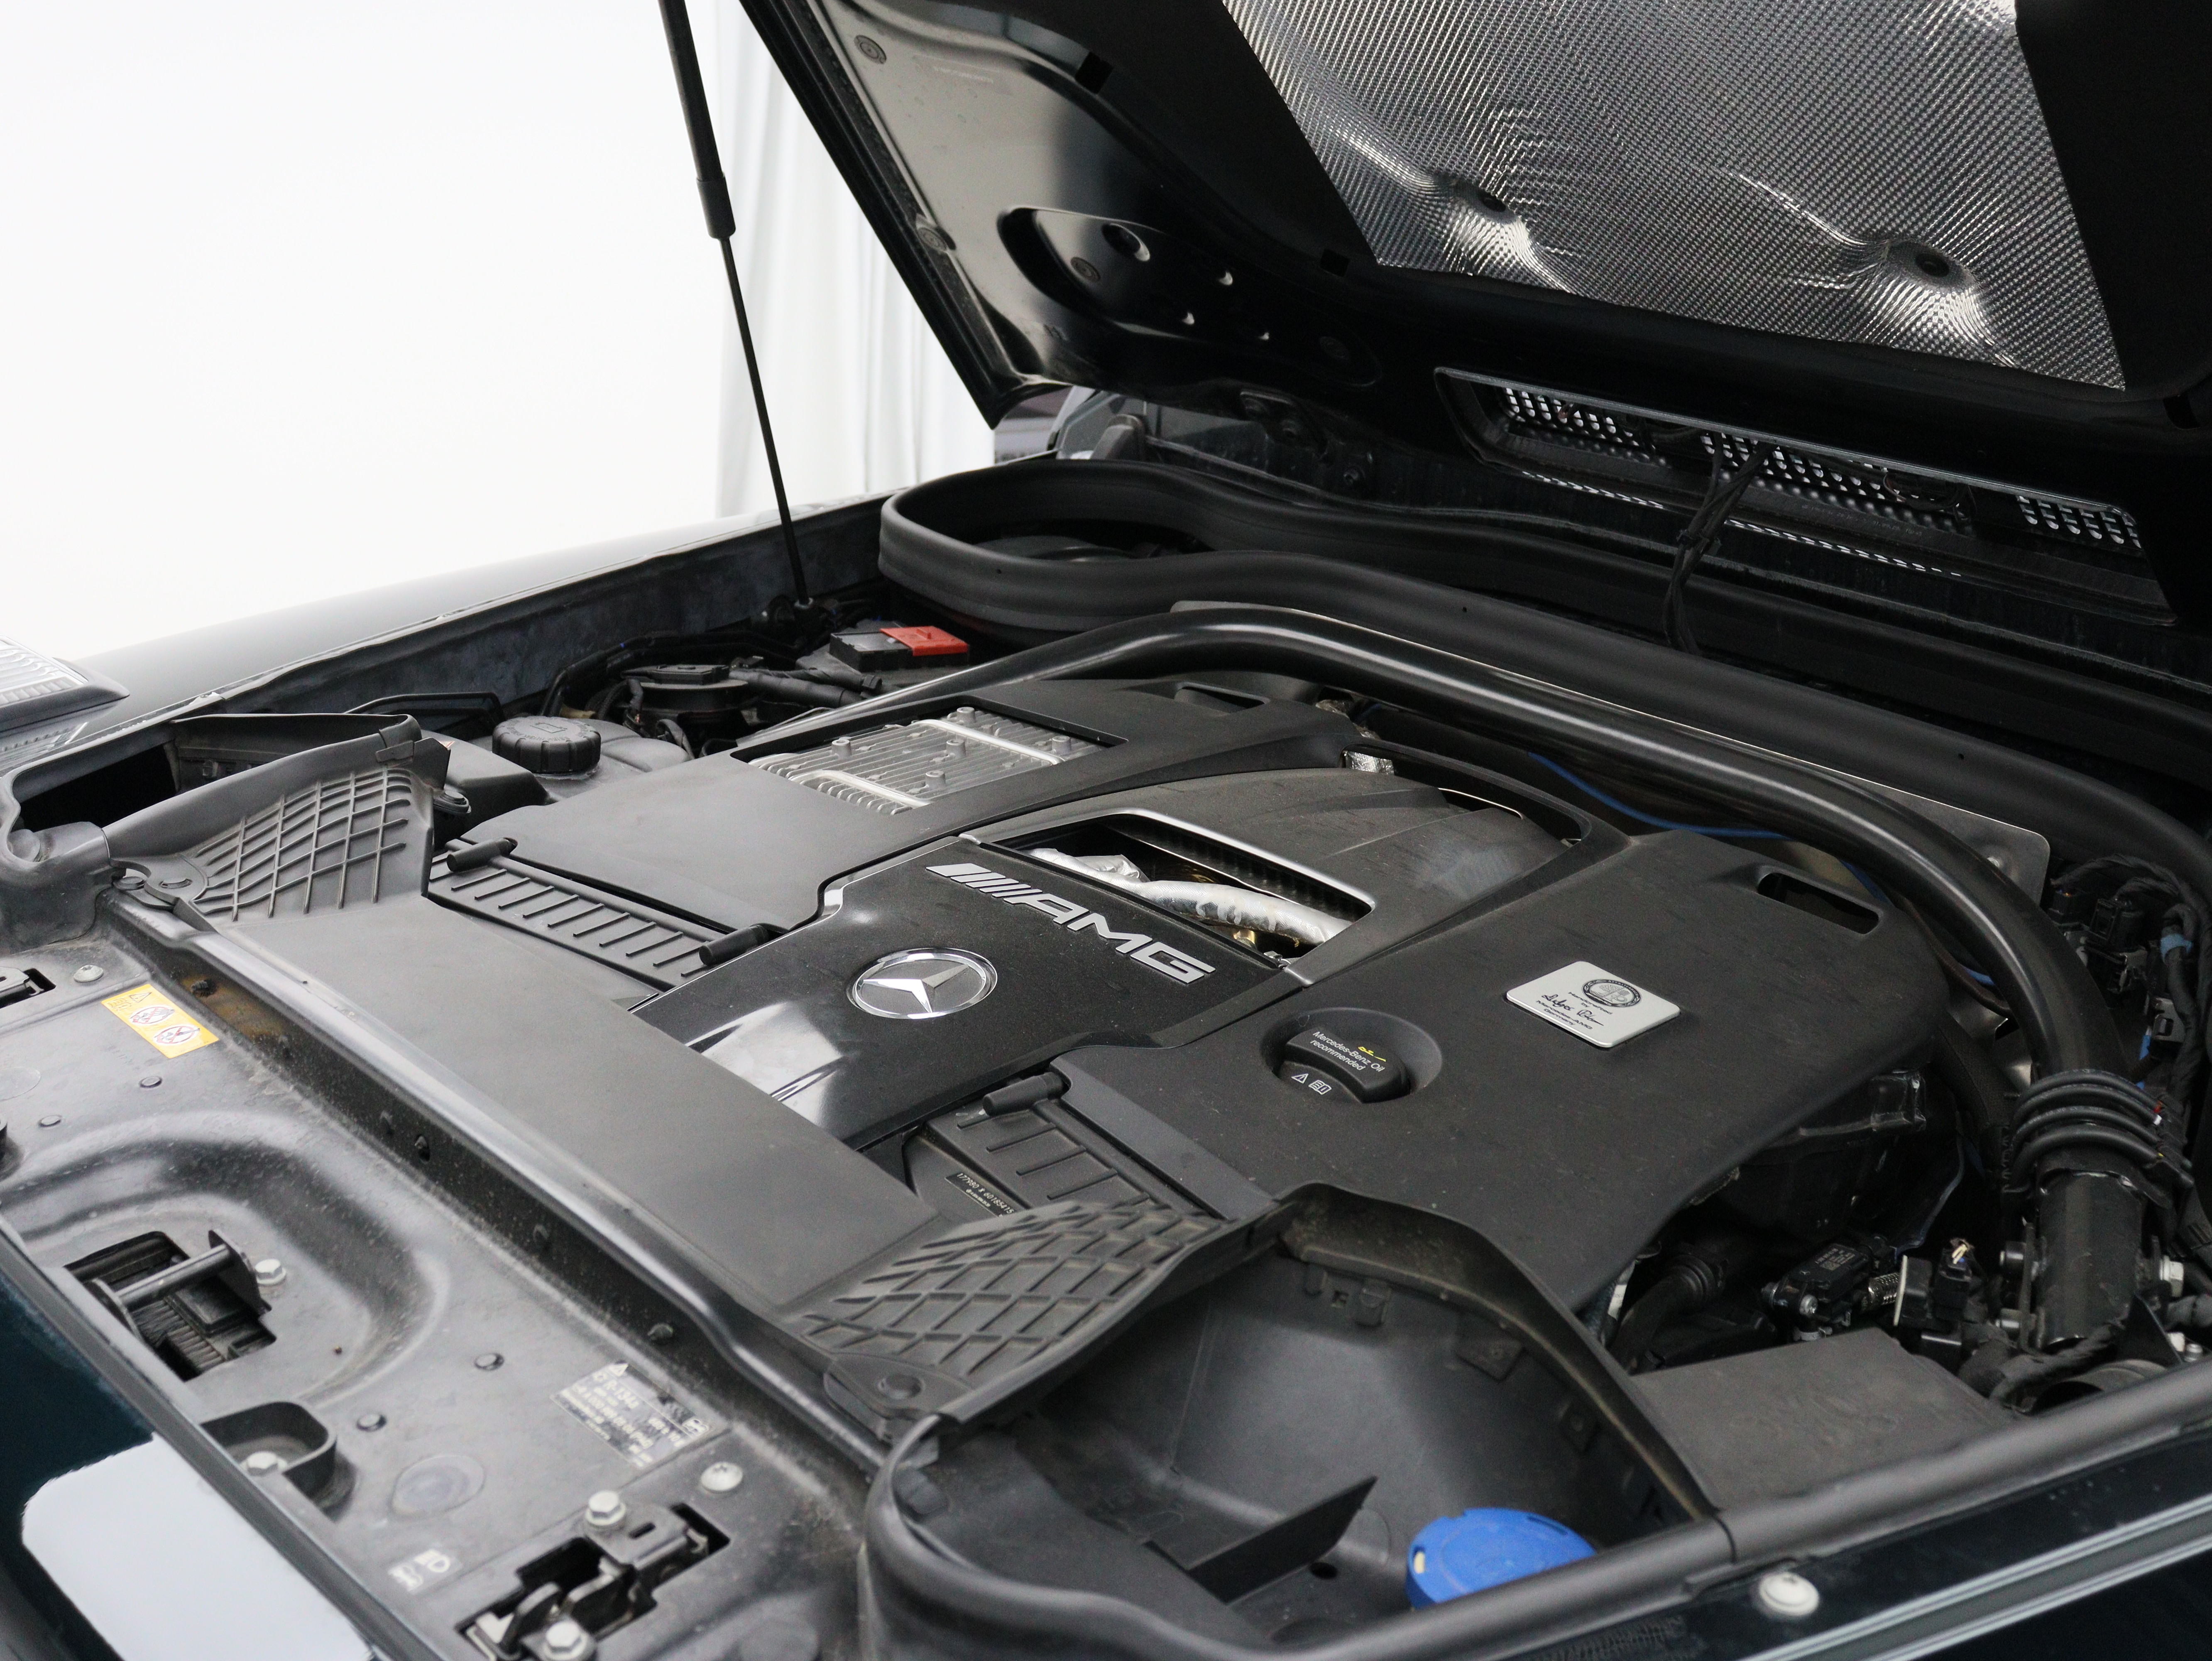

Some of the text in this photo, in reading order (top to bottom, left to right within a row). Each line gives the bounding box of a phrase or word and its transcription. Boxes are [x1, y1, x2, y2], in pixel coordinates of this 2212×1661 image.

[1003, 893, 1216, 985] AMG
[1536, 1000, 1593, 1029] Mercedes-AMG
[1544, 1009, 1576, 1025] Germany
[1568, 992, 1613, 1014] Handcrafted
[1310, 1040, 1366, 1071] recommended
[1313, 1031, 1385, 1072] Mercedes-Benz Oil
[603, 1379, 640, 1409] R-134a
